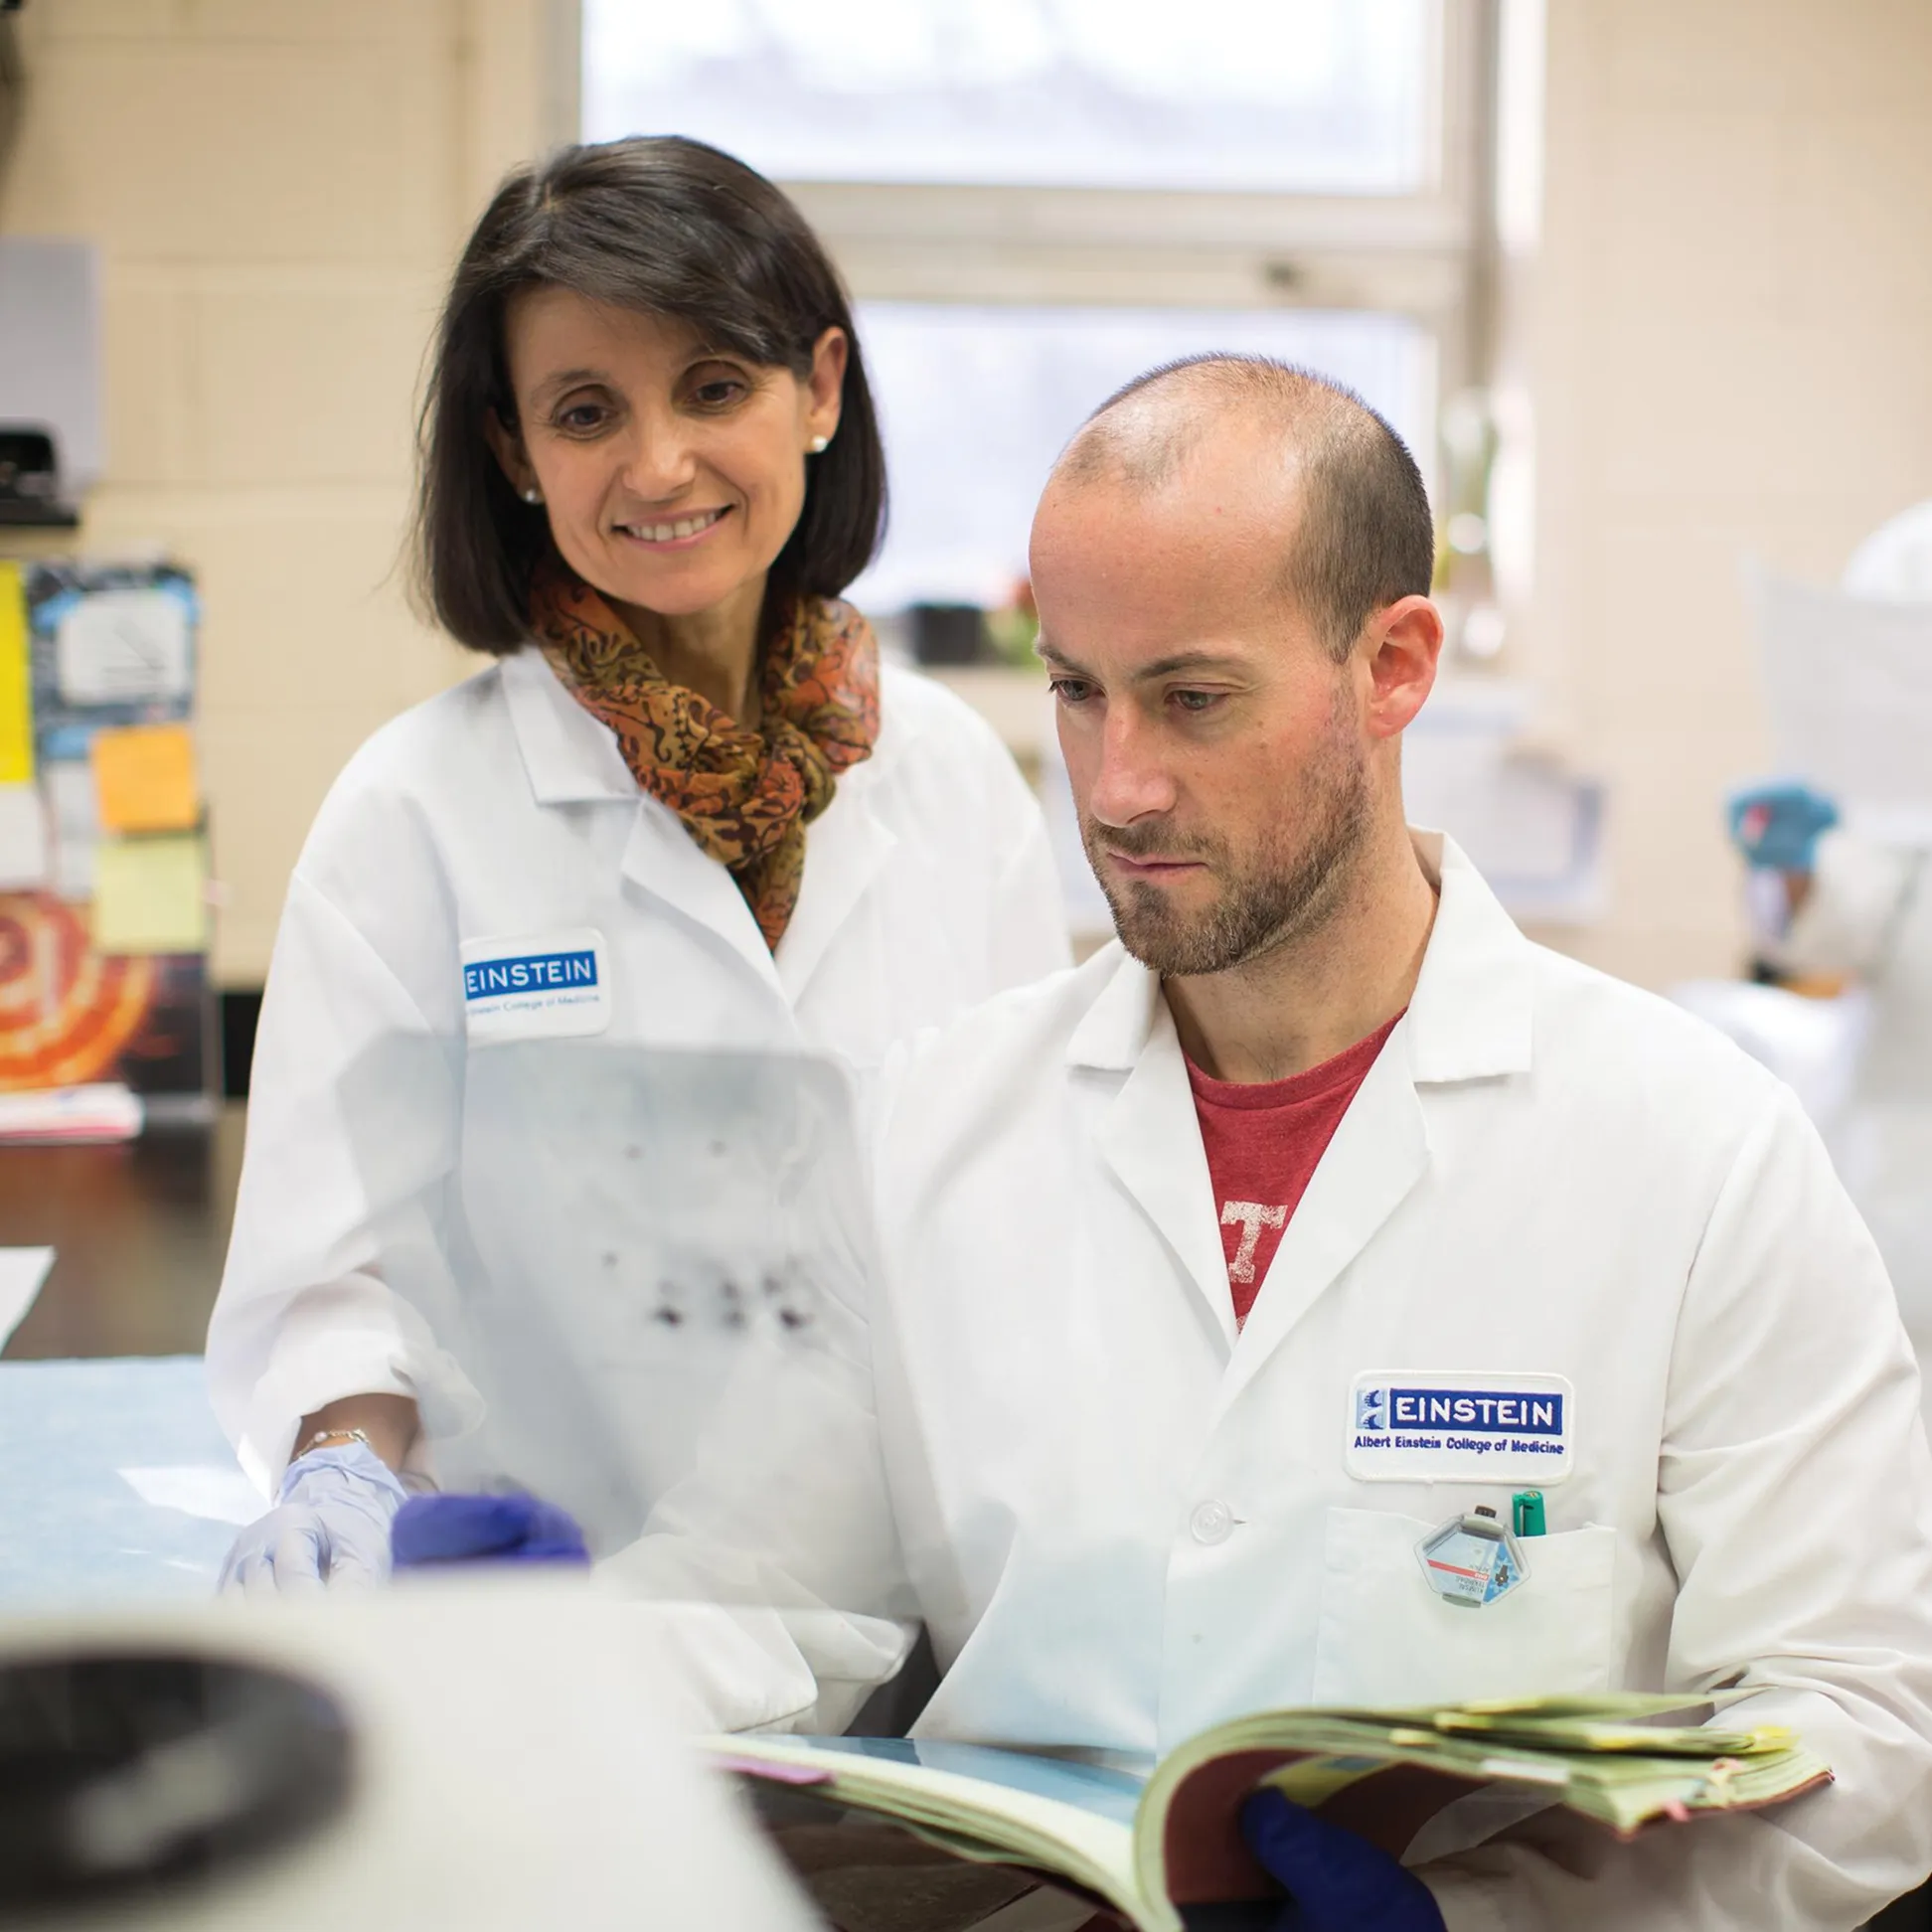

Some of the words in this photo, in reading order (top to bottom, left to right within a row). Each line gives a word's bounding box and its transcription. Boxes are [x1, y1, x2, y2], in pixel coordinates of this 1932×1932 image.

[466, 958, 591, 994] EINSTEIN
[1396, 1396, 1553, 1426] EINSTEIN
[1355, 1435, 1391, 1449] Albert
[1395, 1436, 1441, 1449] Einstein
[1447, 1436, 1492, 1455] College
[1495, 1439, 1508, 1452] of
[1512, 1439, 1564, 1455] Medicine
